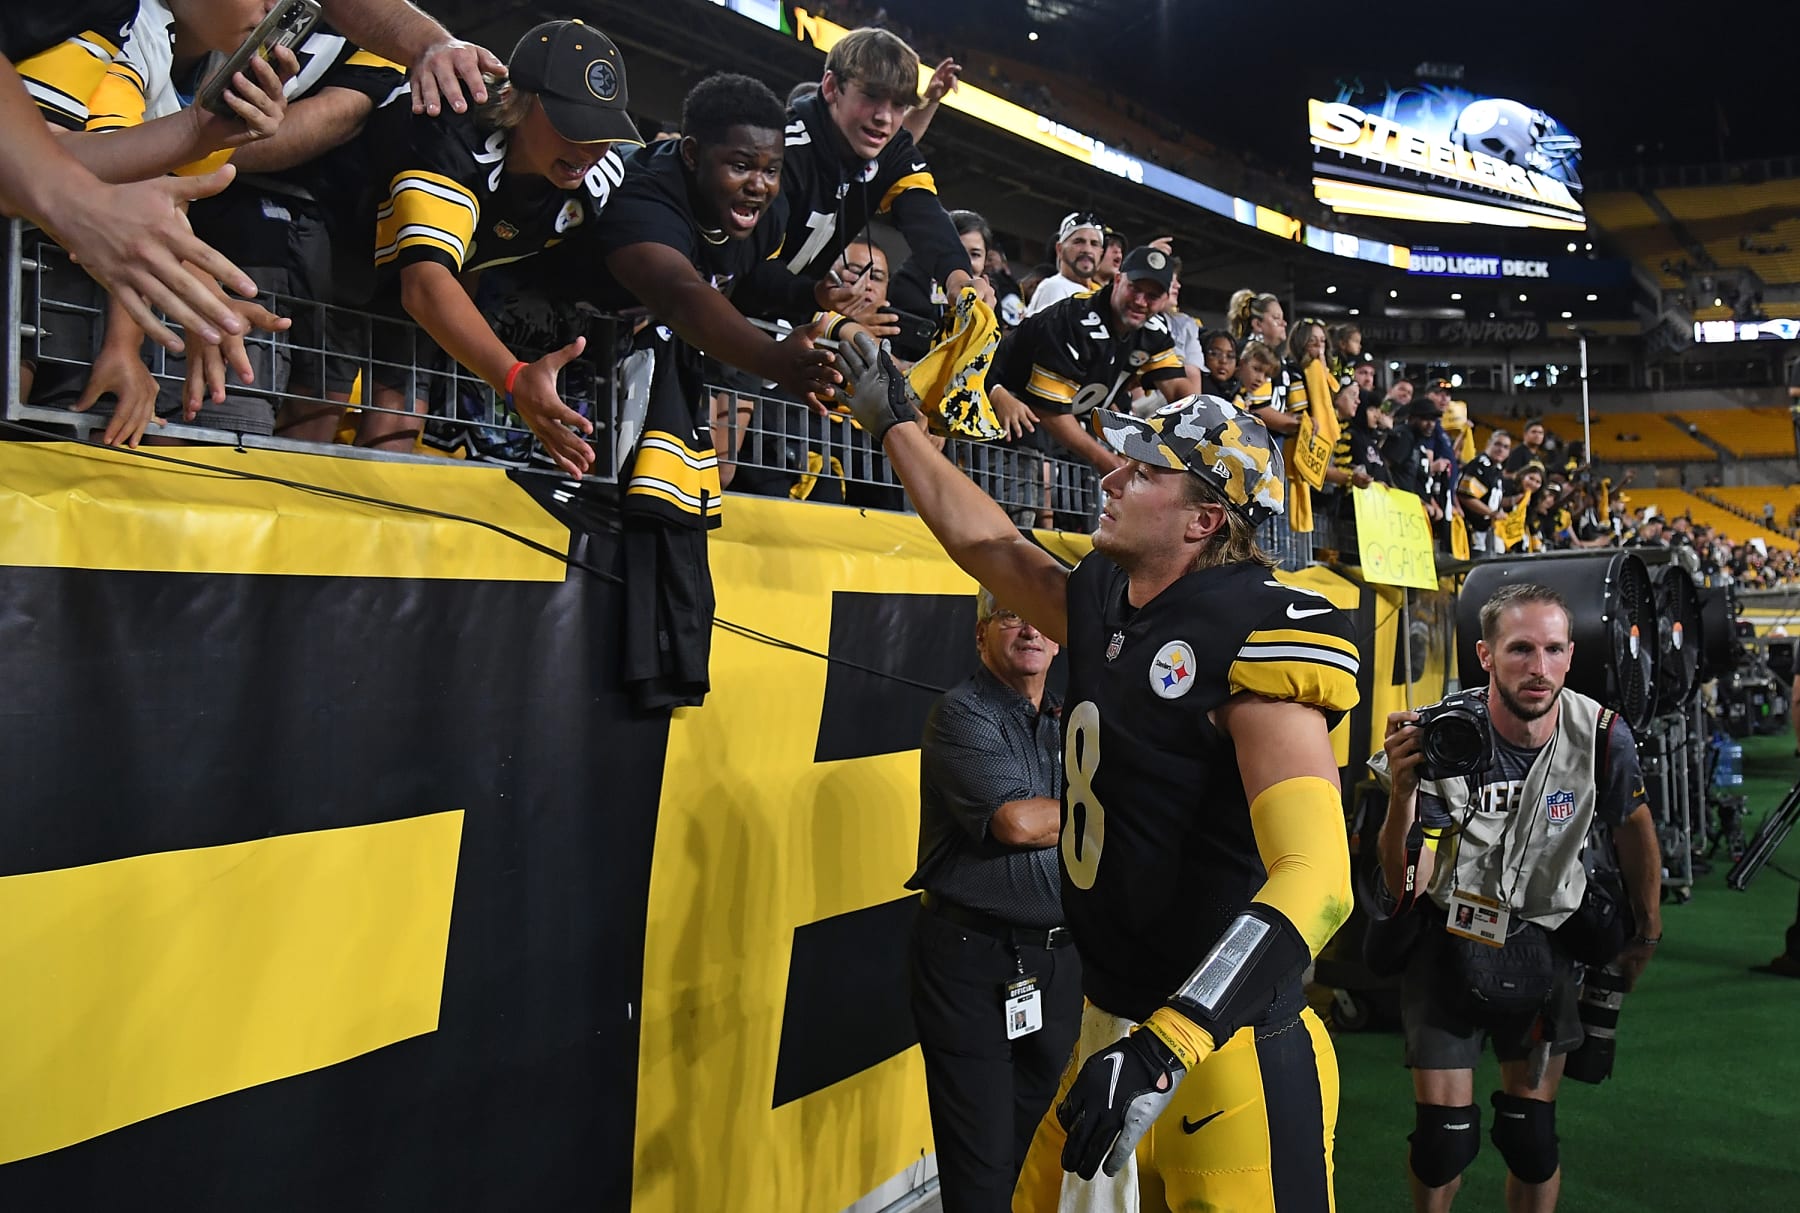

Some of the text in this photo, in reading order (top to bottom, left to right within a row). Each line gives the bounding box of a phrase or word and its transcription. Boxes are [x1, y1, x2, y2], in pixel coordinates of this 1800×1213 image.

[1317, 102, 1534, 193] STEELERS
[1410, 254, 1549, 277] BUD LIGHT DECK
[1080, 311, 1110, 339] 97
[1156, 659, 1172, 671] Steelers
[1062, 701, 1104, 889] 8
[1551, 803, 1573, 818] NFL
[1406, 865, 1415, 892] EOS
[1010, 984, 1035, 998] OFFICIAL
[1156, 1024, 1177, 1048] FOOTBALL
